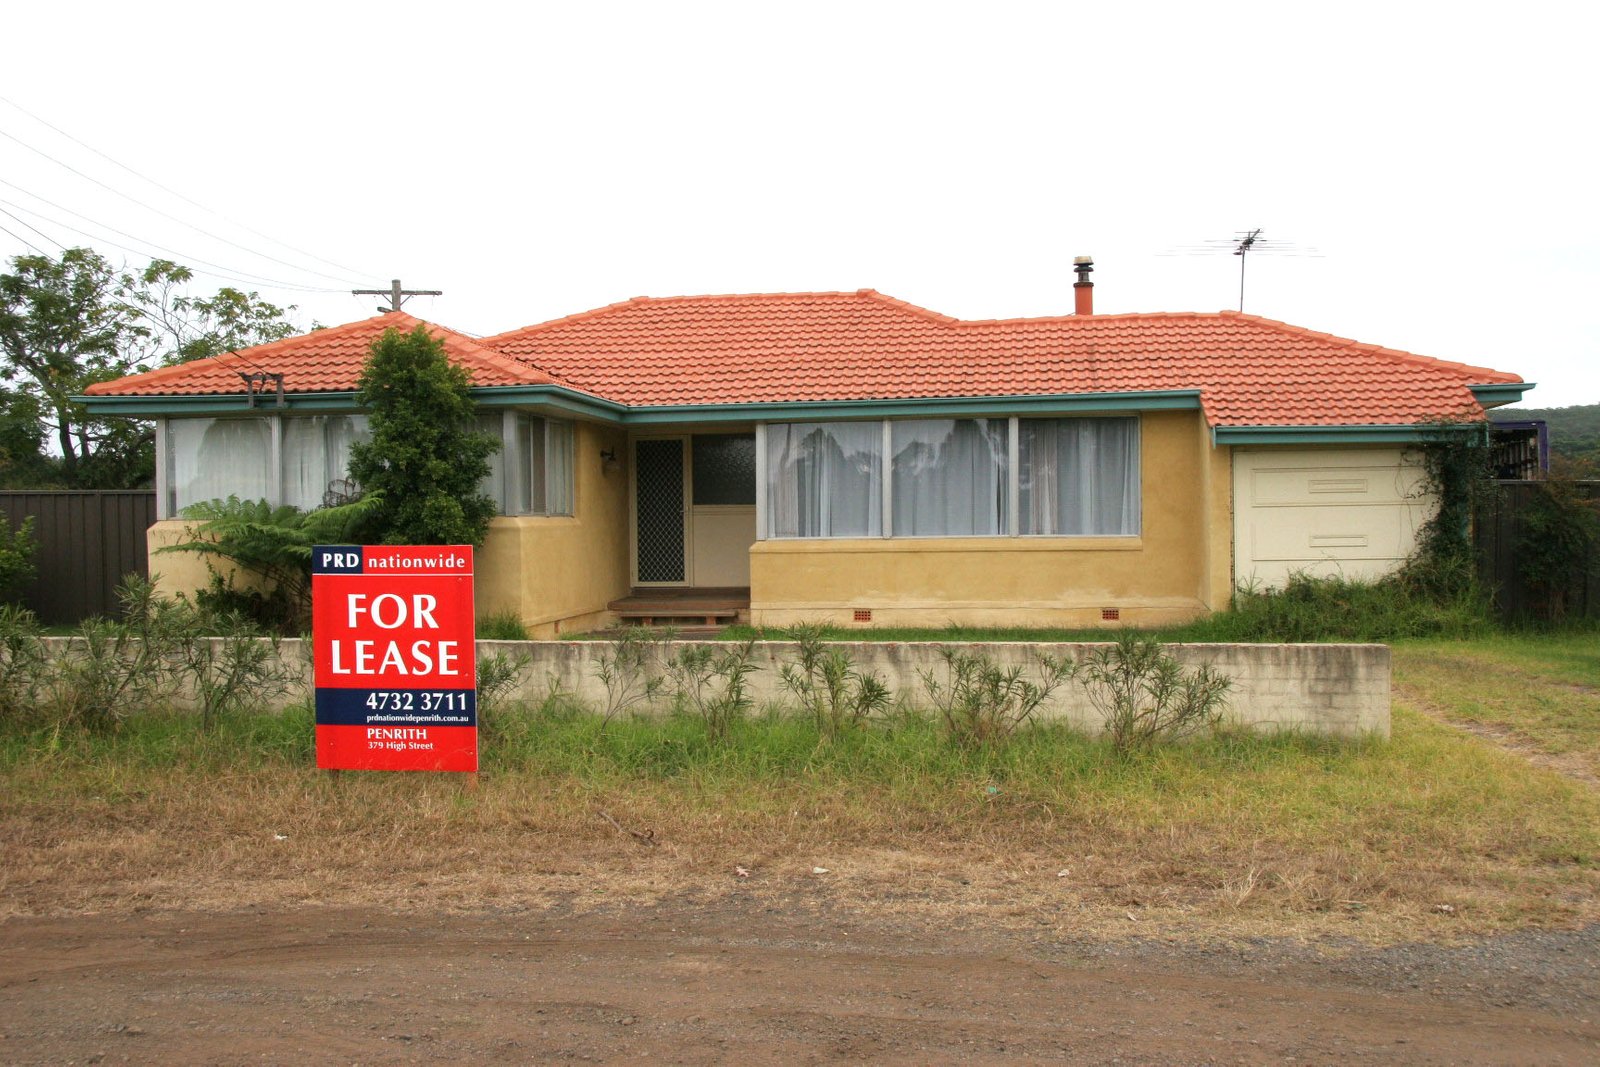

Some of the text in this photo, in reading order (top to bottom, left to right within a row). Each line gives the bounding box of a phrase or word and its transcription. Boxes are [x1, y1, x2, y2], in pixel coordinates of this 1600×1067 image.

[322, 553, 466, 569] PRD nationwide
[347, 593, 440, 629] FOR
[331, 639, 459, 676] LEASE
[366, 692, 467, 711] 4732 3711
[366, 713, 469, 723] prdnationwidepenrith.com.au
[367, 728, 428, 740] PENRITH
[367, 741, 434, 751] 379 High Street
